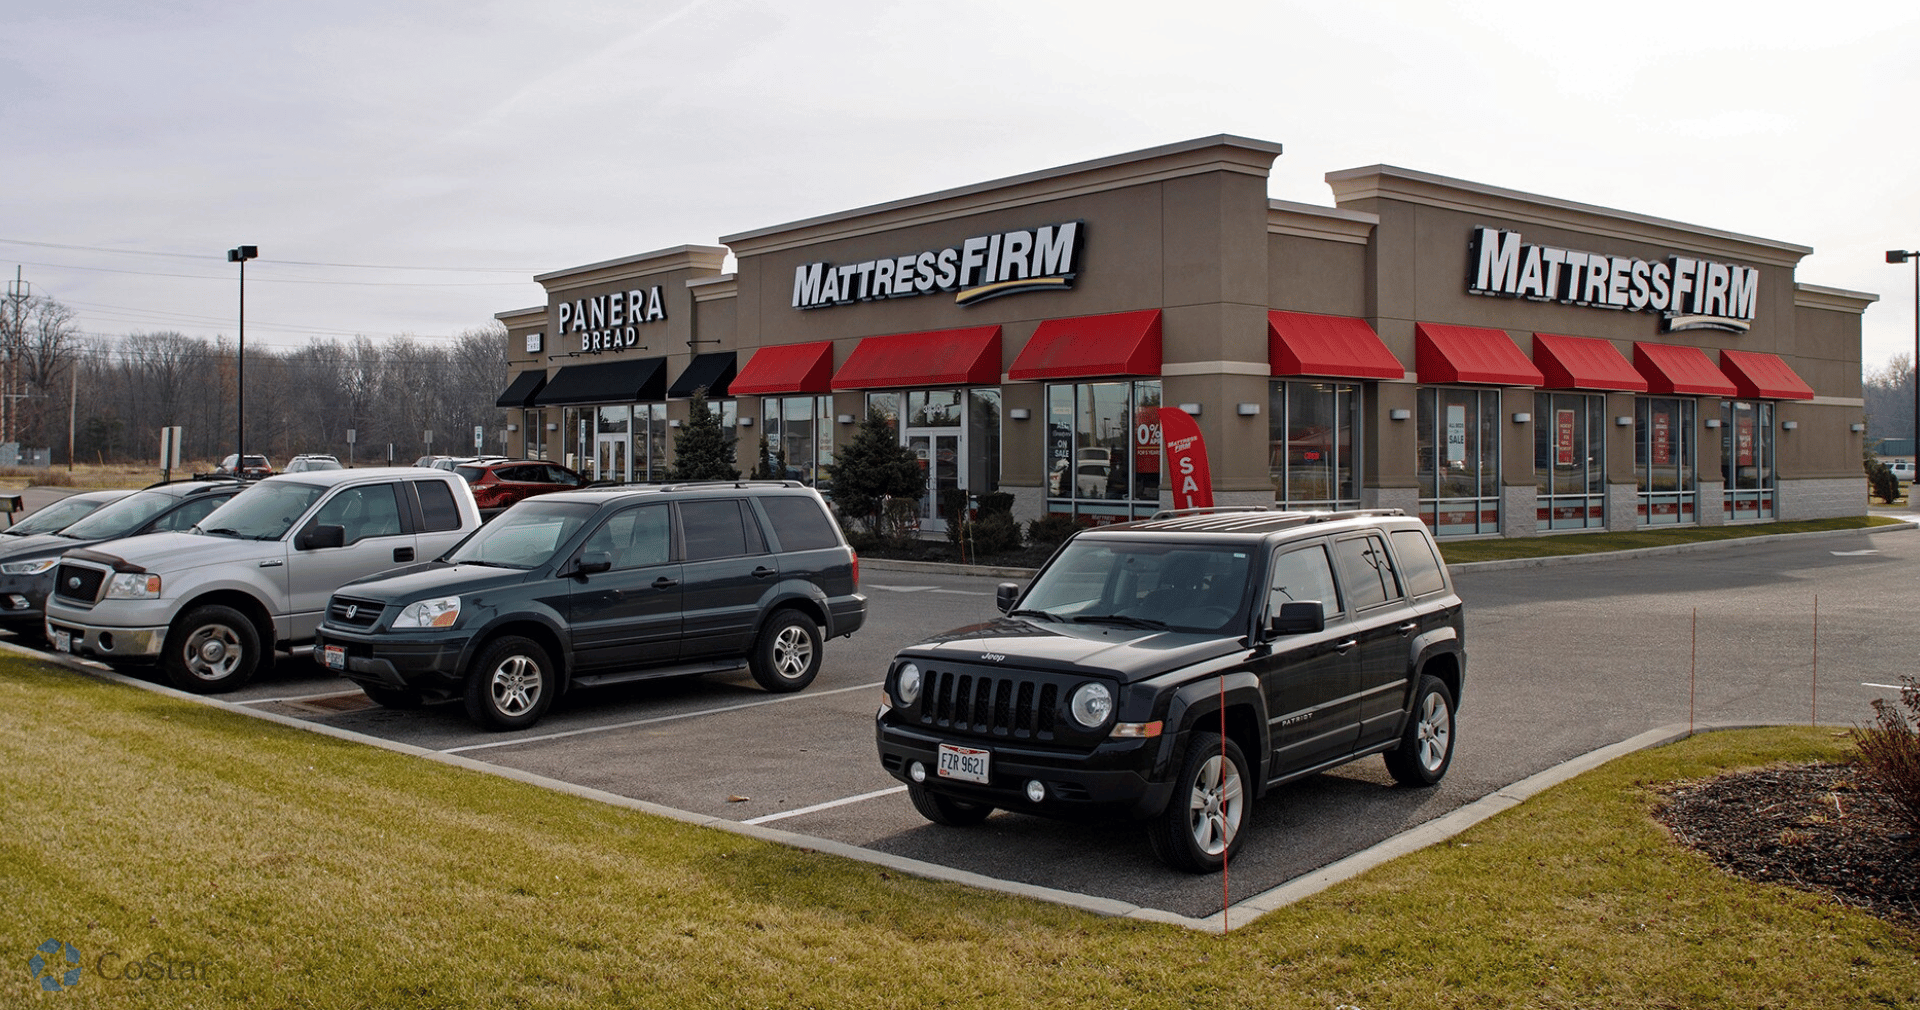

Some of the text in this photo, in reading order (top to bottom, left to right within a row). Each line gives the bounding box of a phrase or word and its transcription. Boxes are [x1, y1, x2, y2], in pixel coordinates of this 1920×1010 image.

[558, 285, 666, 335] PANERA
[581, 326, 637, 351] BREAD
[1057, 440, 1068, 448] ON
[1167, 435, 1198, 449] MATTRESS
[1449, 435, 1464, 444] SALE
[1054, 450, 1070, 458] SALE
[1174, 442, 1191, 454] FIRM
[981, 652, 1006, 662] Jeep
[1282, 712, 1314, 727] PATRIOT
[941, 752, 984, 776] FZR 9621
